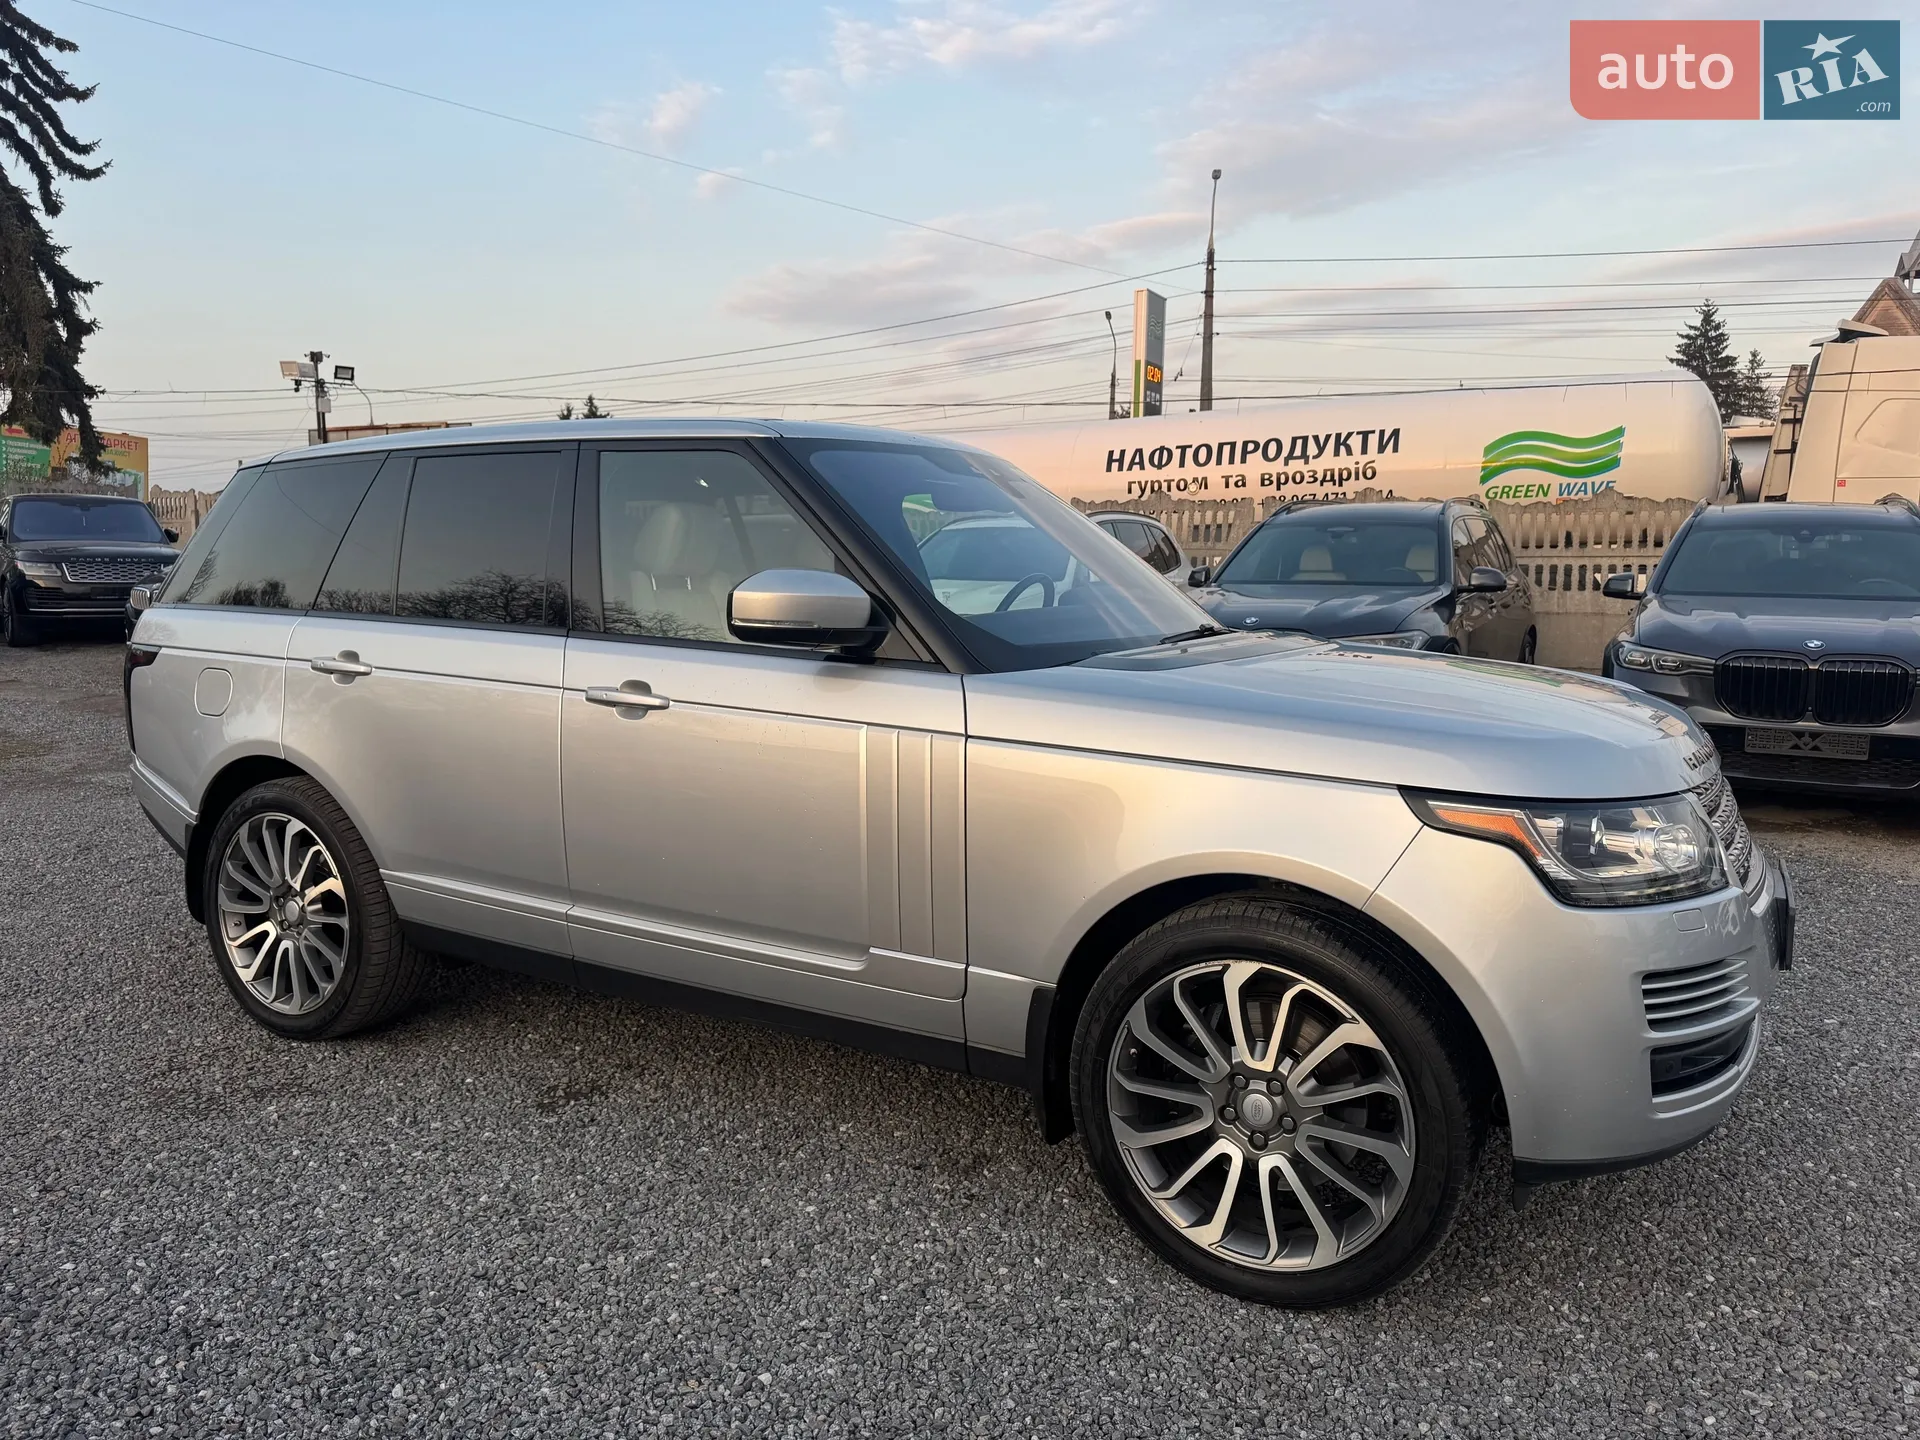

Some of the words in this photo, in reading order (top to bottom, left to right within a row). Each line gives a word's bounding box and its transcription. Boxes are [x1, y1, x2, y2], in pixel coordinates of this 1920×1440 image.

[65, 432, 140, 451] АГМАРКЕТ
[1105, 428, 1401, 473] НАФТОПРОДУКТИ
[1127, 476, 1209, 499] гуртом
[1221, 474, 1247, 489] та
[1260, 460, 1377, 491] вроздріб
[1485, 483, 1551, 499] GREEN
